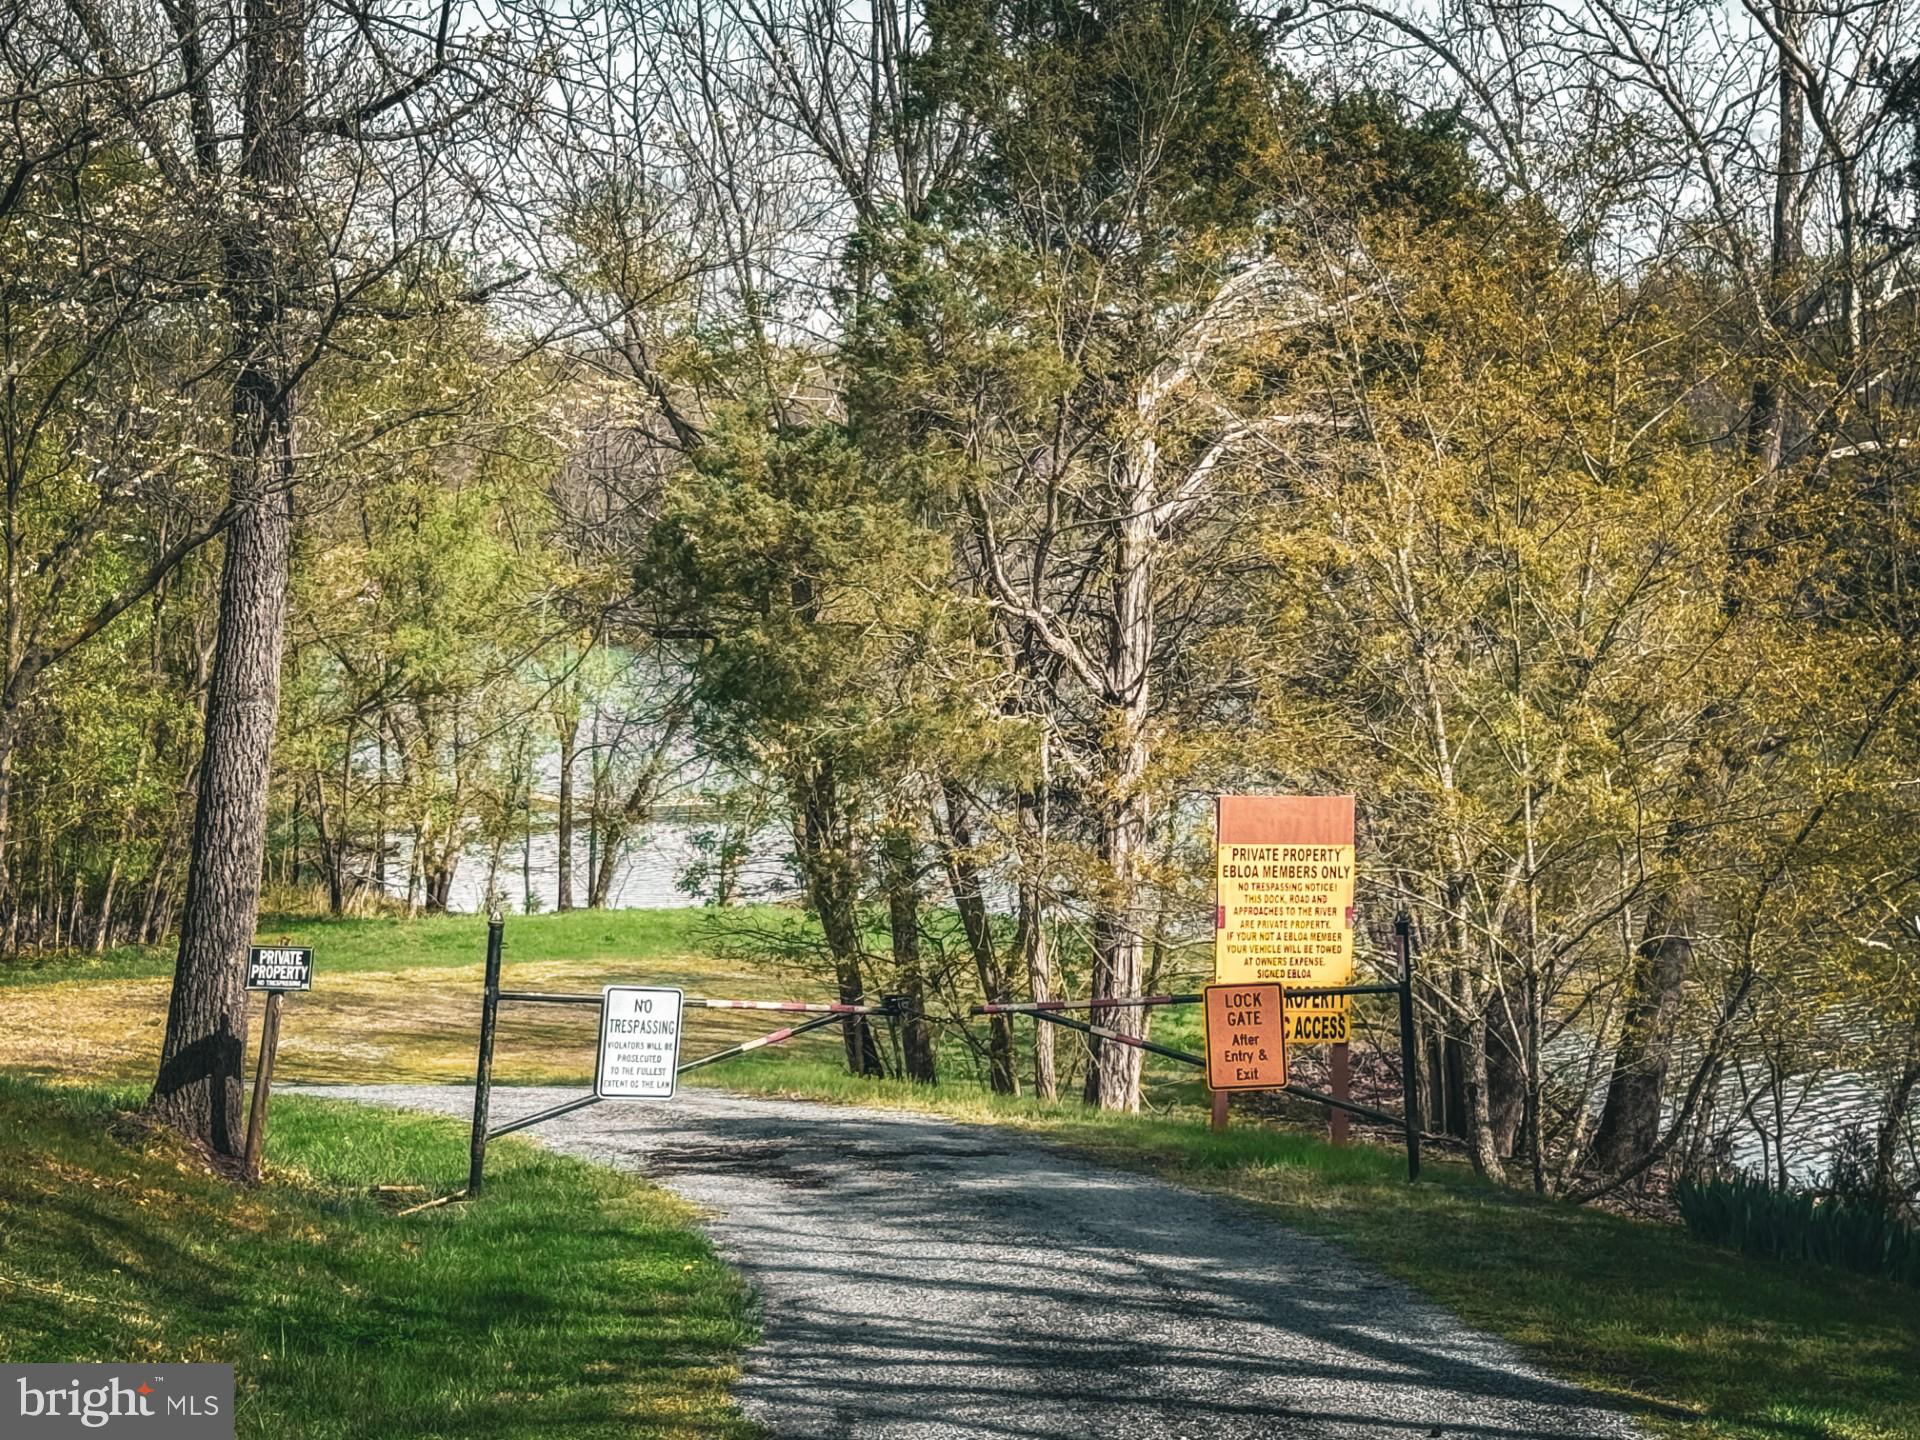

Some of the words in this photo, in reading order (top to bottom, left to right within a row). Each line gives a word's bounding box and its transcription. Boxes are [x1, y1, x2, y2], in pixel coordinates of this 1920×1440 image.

[1232, 848, 1279, 862] PRIVATE
[1283, 848, 1341, 862] PROPERTY
[1223, 865, 1259, 878] EBLOA
[1262, 865, 1317, 878] MEMBERS
[1321, 866, 1350, 879] ONLY
[1238, 883, 1249, 891] NO
[1252, 883, 1302, 892] TRESPASSING
[1245, 895, 1262, 903] THIS
[1290, 895, 1309, 903] ROAD
[1312, 895, 1327, 904] AND
[1234, 907, 1284, 916] APPROACHES
[1286, 907, 1295, 916] TO
[1299, 907, 1312, 916] THE
[1314, 907, 1337, 916] RIVER
[1240, 920, 1254, 929] ARE
[1257, 920, 1288, 929] PRIVATE
[1227, 932, 1234, 941] IF
[1237, 932, 1257, 941] YOUR
[1260, 932, 1274, 941] NOT
[1276, 932, 1282, 941] A
[1284, 932, 1308, 941] EBLOA
[1310, 932, 1342, 942] MEMBER
[1227, 944, 1247, 954] YOUR
[1249, 945, 1281, 954] VEHICLE
[1284, 945, 1301, 954] WILL
[1304, 945, 1314, 954] BE
[1316, 945, 1342, 954] TOWED
[259, 950, 304, 965] PRIVATE
[1244, 957, 1253, 966] AT
[1255, 957, 1287, 966] OWNERS
[250, 964, 308, 980] PROPERTY
[1257, 969, 1285, 978] SIGNED
[1287, 969, 1311, 978] EBLOA
[634, 998, 653, 1014] NO
[1225, 993, 1262, 1008] LOCK
[1227, 1011, 1262, 1026] GATE
[610, 1018, 675, 1035] TRESPASSING
[1294, 1016, 1345, 1039] ACCESS
[1232, 1034, 1259, 1046] After
[608, 1041, 644, 1050] VIOLATORS
[646, 1042, 662, 1051] WILL
[664, 1042, 673, 1051] BE
[617, 1053, 662, 1063] PROSECUTED
[1224, 1050, 1253, 1063] Entry
[1258, 1049, 1268, 1061] &
[610, 1066, 619, 1075] TO
[622, 1066, 635, 1075] THE
[636, 1067, 666, 1076] FULLEST
[1236, 1068, 1259, 1080] Exit
[641, 1080, 654, 1089] THE
